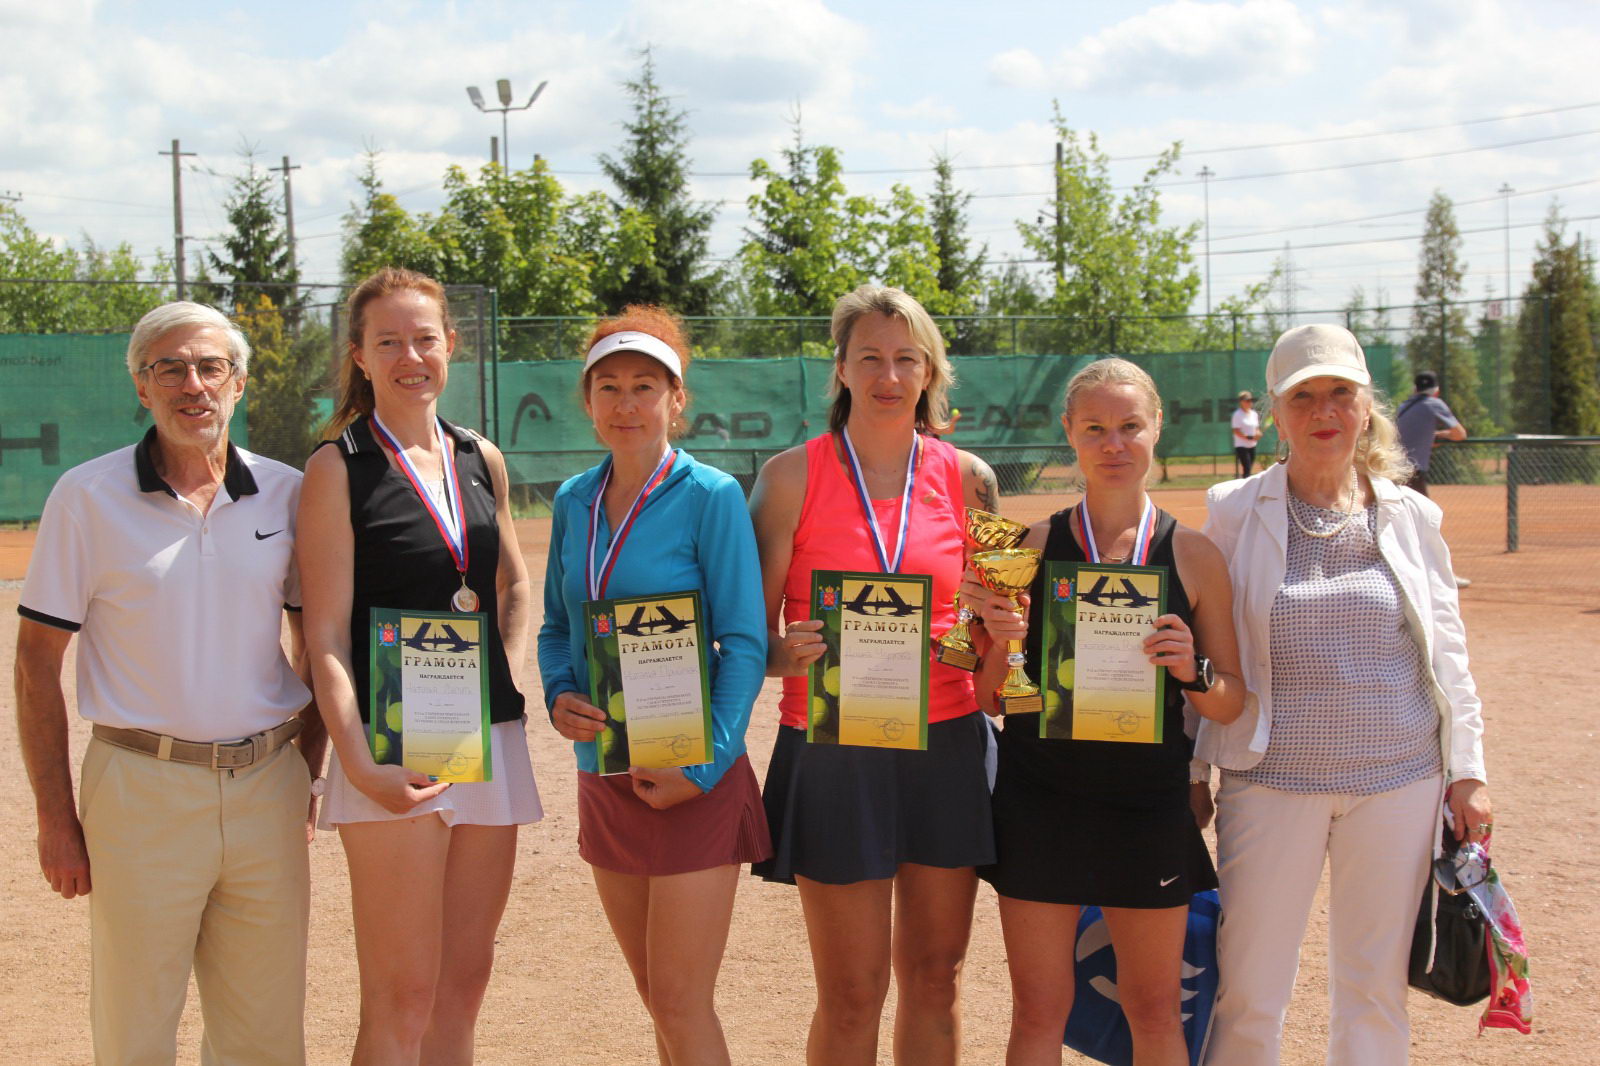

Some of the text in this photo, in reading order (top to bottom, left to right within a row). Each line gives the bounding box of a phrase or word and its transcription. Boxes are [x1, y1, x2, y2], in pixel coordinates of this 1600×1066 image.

[947, 404, 1052, 431] EAD
[1078, 611, 1154, 625] ГРАМОТА
[844, 620, 919, 634] ГРАМОТА
[1093, 629, 1141, 637] НАГРАЖДАЕТСЯ
[621, 637, 695, 654] ГРАМОТА
[858, 638, 905, 646] НАГРАЖДАЕТСЯ
[404, 656, 477, 669] ГРАМОТА
[638, 655, 683, 665] НАГРАЖДАЕТСЯ
